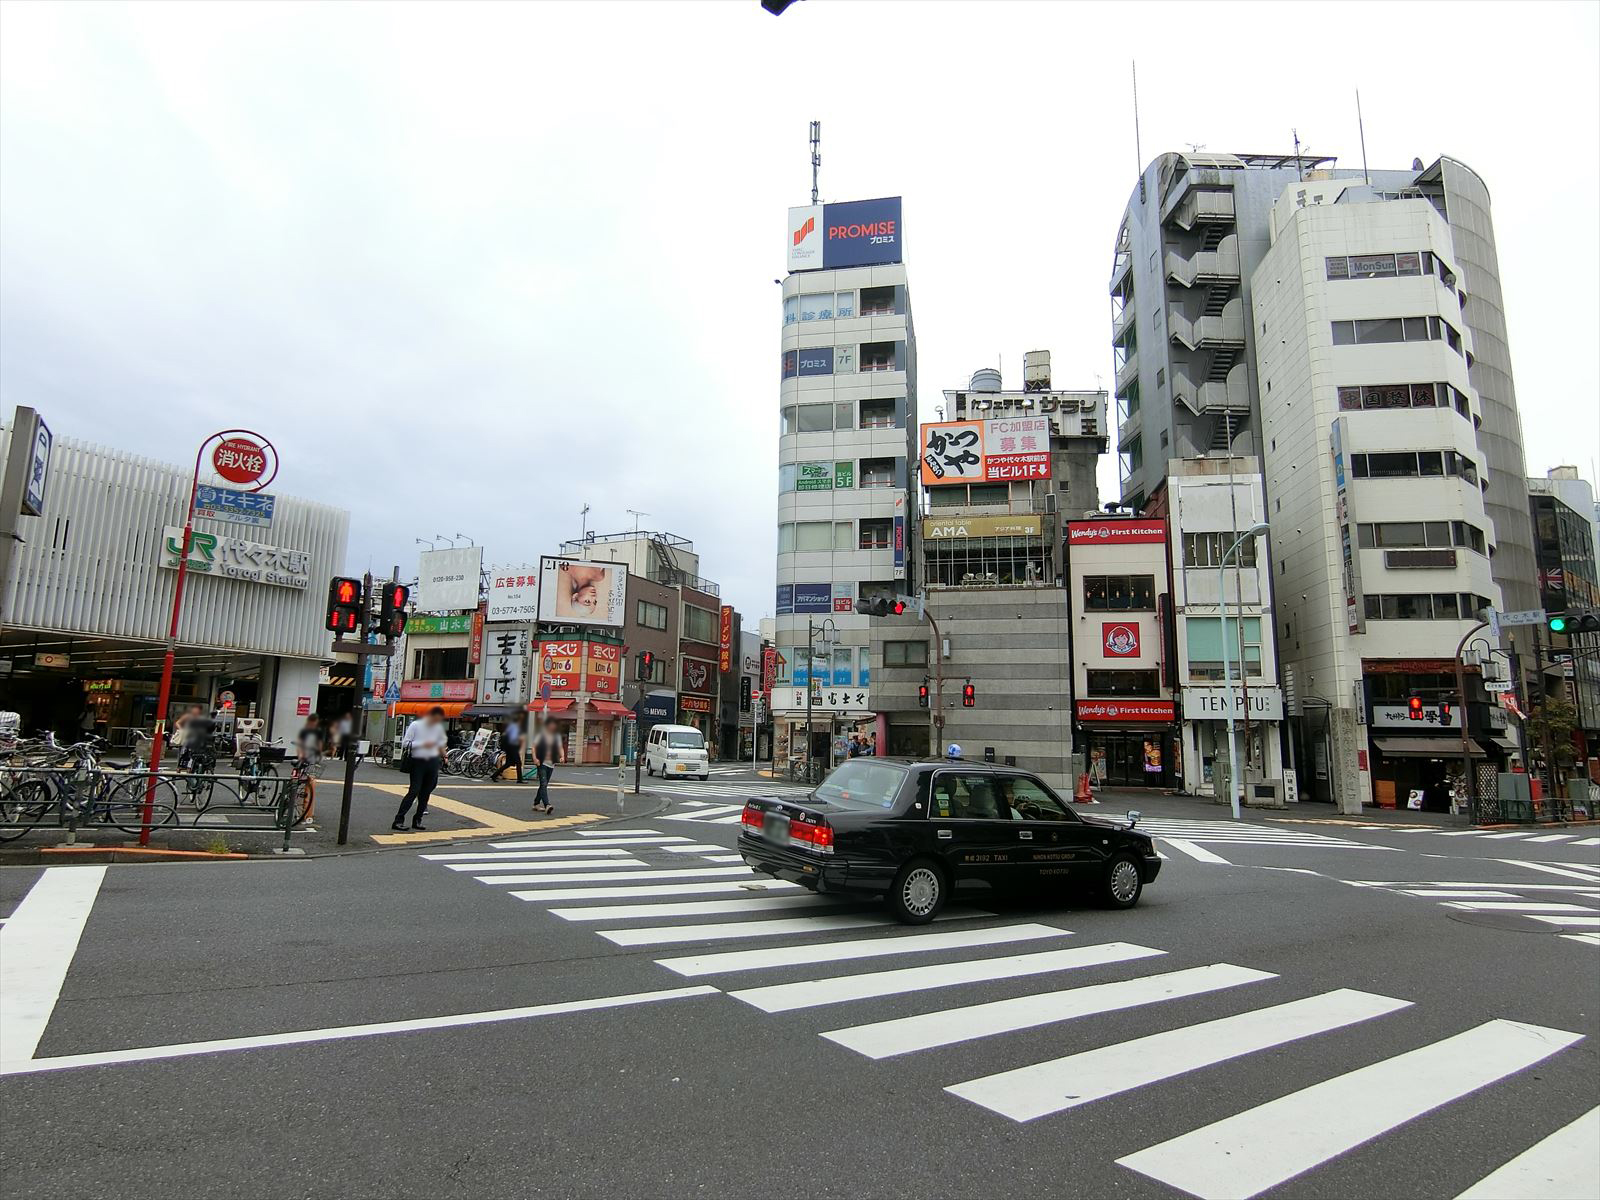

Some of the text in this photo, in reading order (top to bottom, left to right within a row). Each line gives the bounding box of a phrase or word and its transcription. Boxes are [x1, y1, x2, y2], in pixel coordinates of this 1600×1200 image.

[829, 221, 895, 240] PROMISE
[870, 236, 894, 244] プロミス
[1355, 261, 1394, 271] MonSun
[800, 360, 826, 368] プロミス
[838, 355, 851, 365] 7F
[1040, 396, 1096, 414] サラン
[990, 420, 1045, 433] FC加盟店
[237, 445, 261, 453] HYDRANT
[1000, 436, 1037, 451] 募集
[217, 449, 264, 473] 消火栓
[988, 464, 1036, 478] 当ビル1F
[837, 477, 851, 487] 5F
[219, 490, 273, 511] セキネ
[931, 526, 968, 537] AMA
[1071, 528, 1097, 538] Wendy's
[167, 532, 217, 561] JR
[221, 538, 309, 574] 代々木駅
[220, 563, 263, 581] Yoyogi
[266, 571, 308, 588] Station
[495, 576, 536, 588] 広告募集
[492, 606, 536, 615] 03-5774-7505
[722, 607, 730, 641] ラーメン
[546, 644, 577, 656] 宝くじ
[593, 646, 615, 659] 宝くじ
[494, 632, 516, 694] 吉そば
[552, 660, 571, 670] OTO 6
[606, 663, 611, 673] 6
[650, 708, 667, 716] MEVIUS
[1078, 704, 1105, 716] Wendy's
